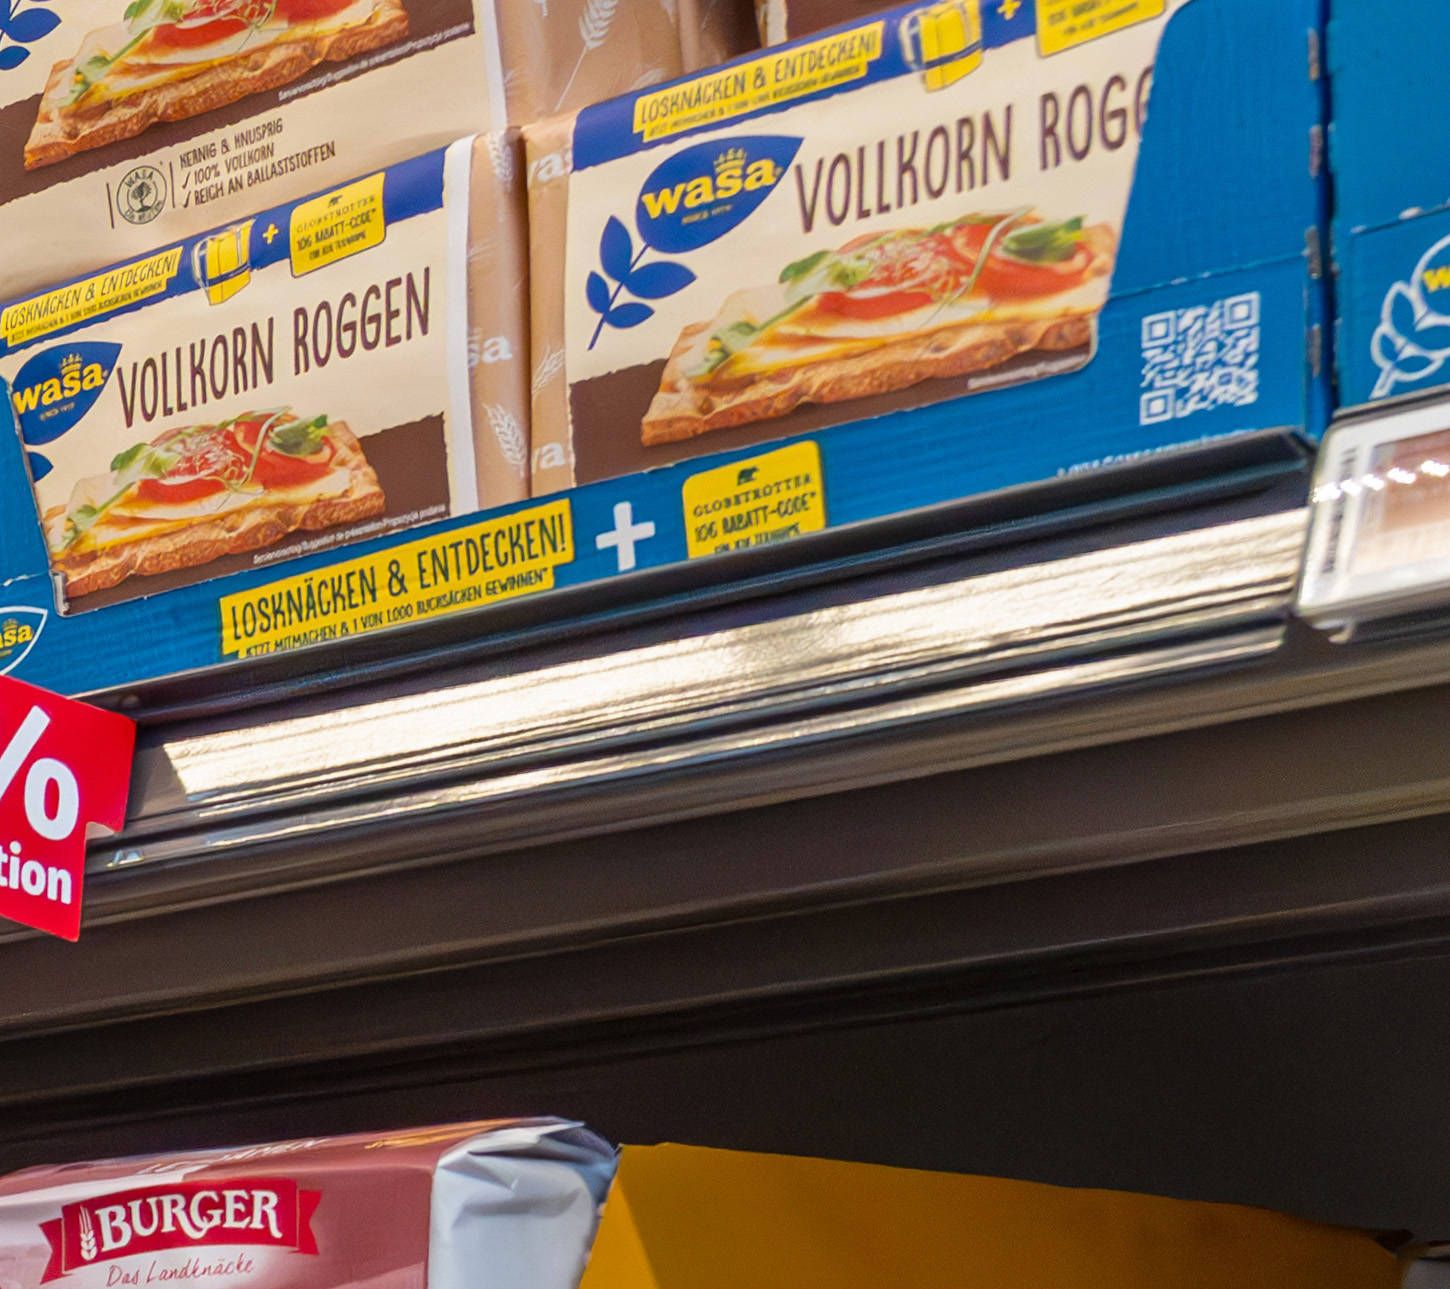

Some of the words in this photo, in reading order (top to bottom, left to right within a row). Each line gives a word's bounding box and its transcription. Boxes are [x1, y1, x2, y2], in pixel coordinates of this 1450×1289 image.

[179, 141, 217, 169] KERNIG
[233, 118, 284, 151] KNUSPRIG
[194, 159, 220, 183] 100%
[194, 182, 225, 207] REICH
[227, 177, 243, 196] AN
[246, 141, 336, 191] BALLASTSTOFFEN
[794, 104, 1014, 234] VOLLKORN
[118, 316, 276, 429] VOLLKORN
[293, 267, 432, 376] ROGGEN
[693, 472, 812, 518] GLOBETROTTER
[230, 574, 379, 641] LOSKNÄCKEN
[387, 565, 409, 600] &
[418, 526, 567, 589] ENTDECKEN!
[97, 1188, 283, 1256] BURGER
[106, 1262, 141, 1289] Das
[145, 1255, 255, 1285] Landknäcke
